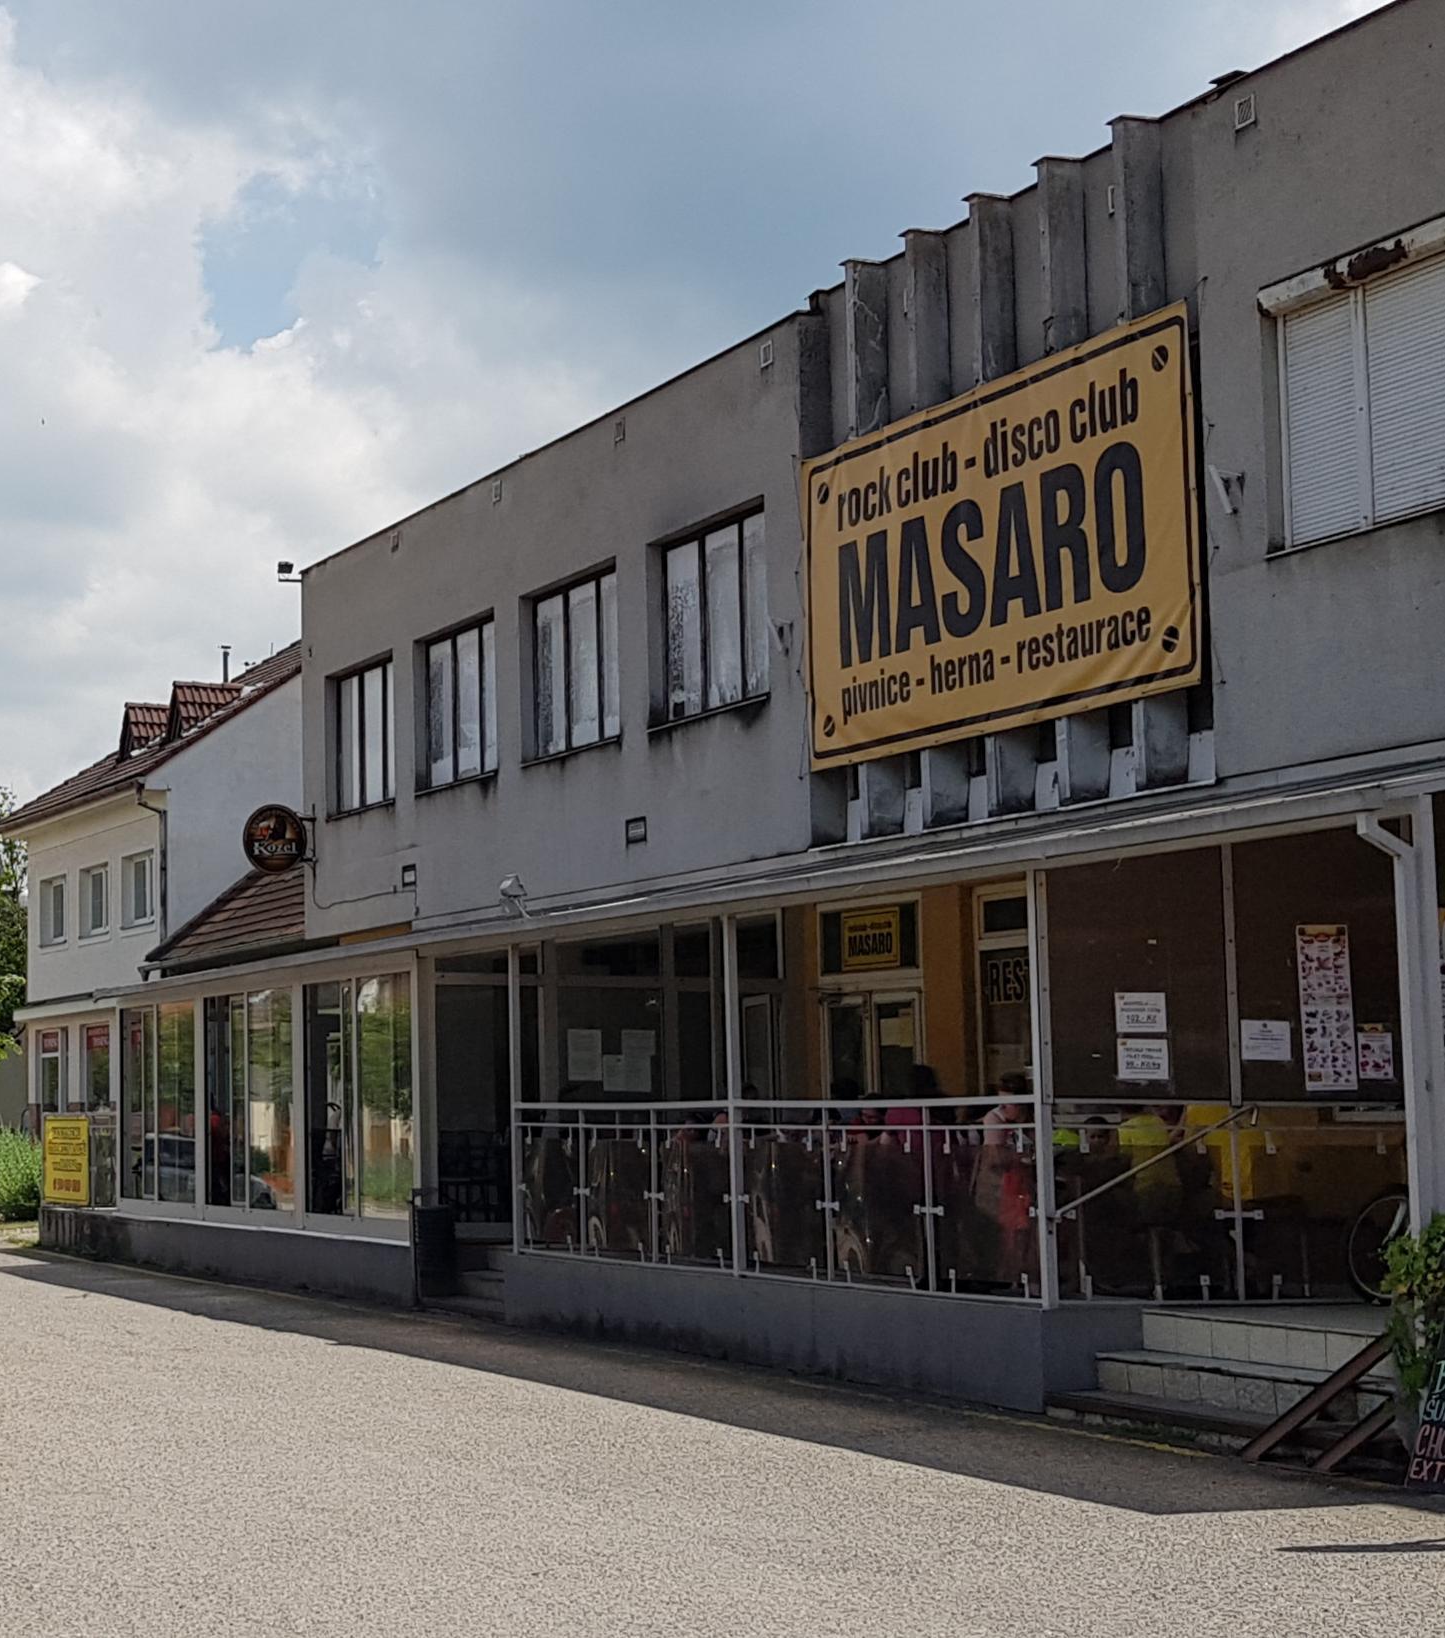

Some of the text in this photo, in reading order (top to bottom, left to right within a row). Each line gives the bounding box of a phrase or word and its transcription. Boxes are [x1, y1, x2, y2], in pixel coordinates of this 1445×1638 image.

[837, 464, 891, 531] rock
[896, 442, 956, 508] club
[984, 408, 1060, 479] disco
[1069, 368, 1139, 443] club
[838, 441, 1146, 669] MASARO
[841, 664, 911, 725] pivnice
[930, 647, 995, 697] herna
[1016, 605, 1151, 674] restaurace
[847, 932, 892, 957] MASARO
[1424, 1395, 1445, 1422] ŠU
[1410, 1459, 1445, 1483] EXT
